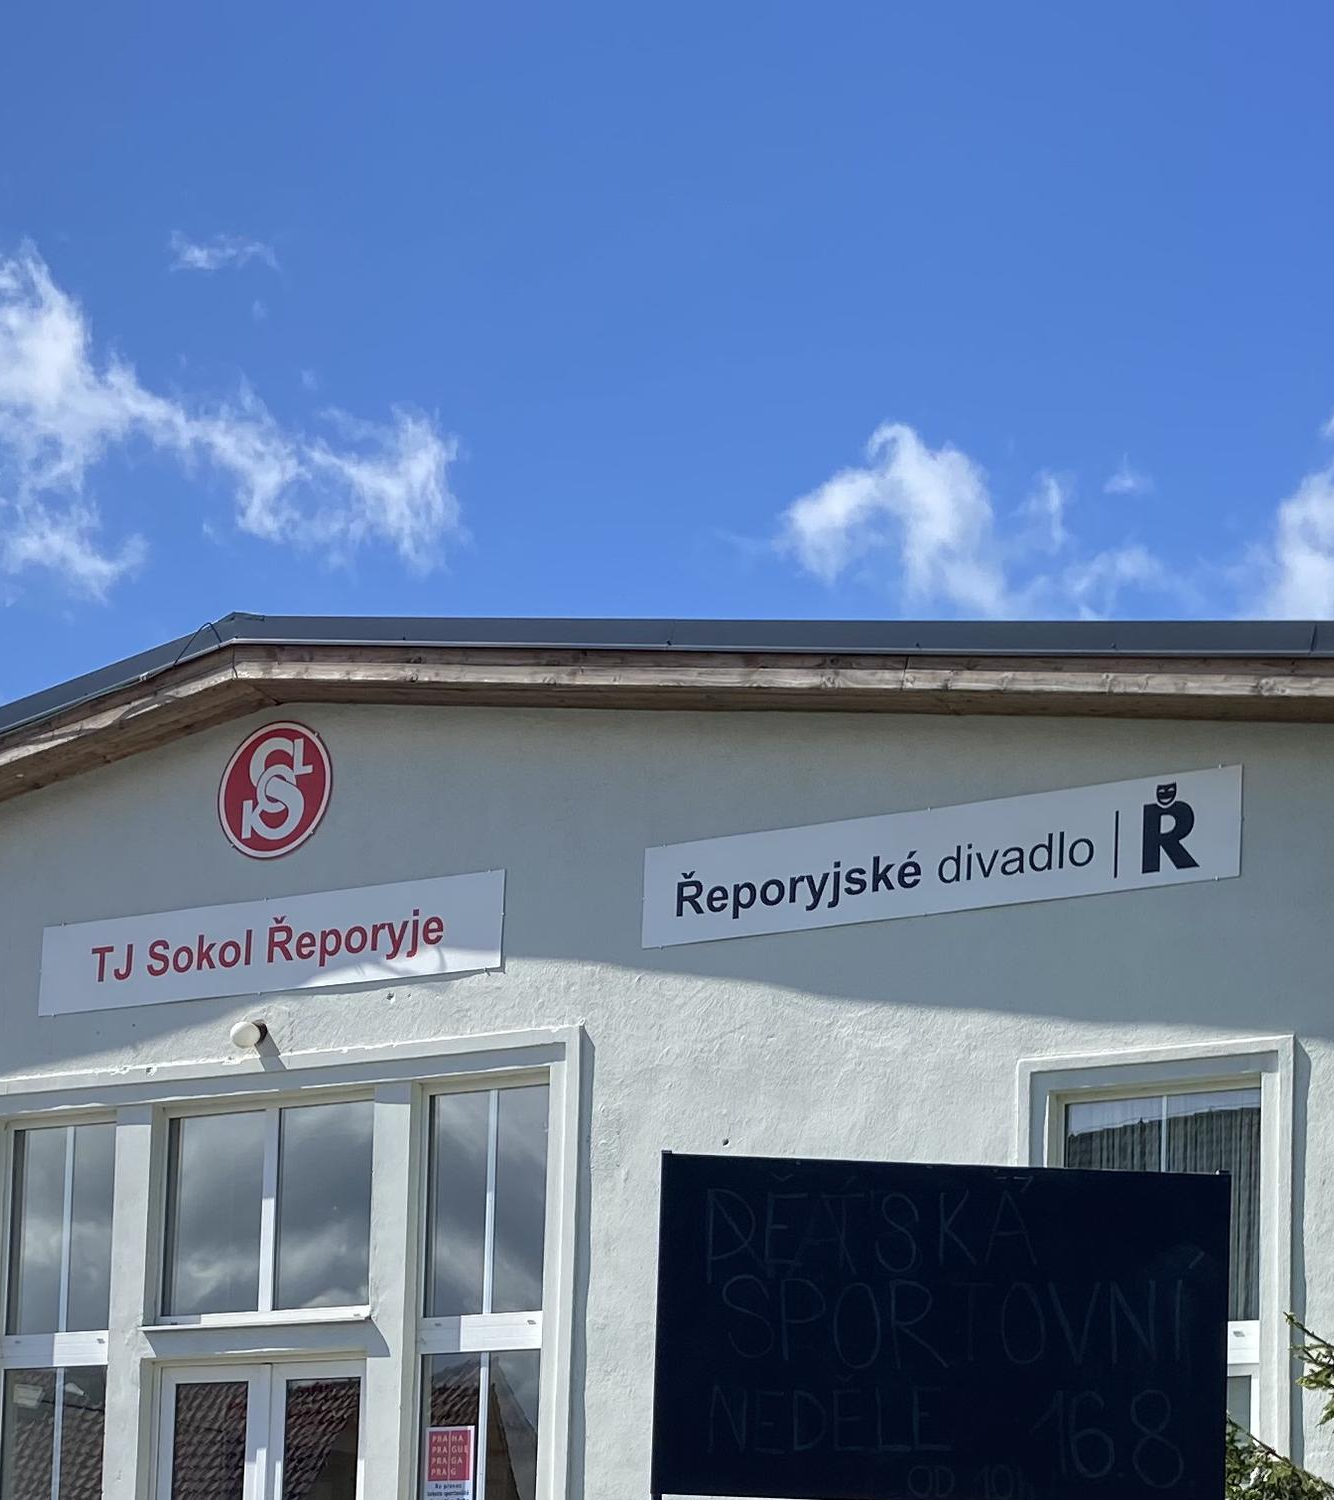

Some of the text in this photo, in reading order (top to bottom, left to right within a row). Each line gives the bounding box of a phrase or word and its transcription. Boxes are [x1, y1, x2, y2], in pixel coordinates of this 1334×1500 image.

[674, 851, 923, 919] Řeporyjské
[938, 830, 1095, 884] divadlo
[91, 907, 445, 983] TJ Sokol Řeporyje
[721, 1251, 1205, 1369] SPORTOVNÍ
[708, 1373, 953, 1455] NEDĚLE
